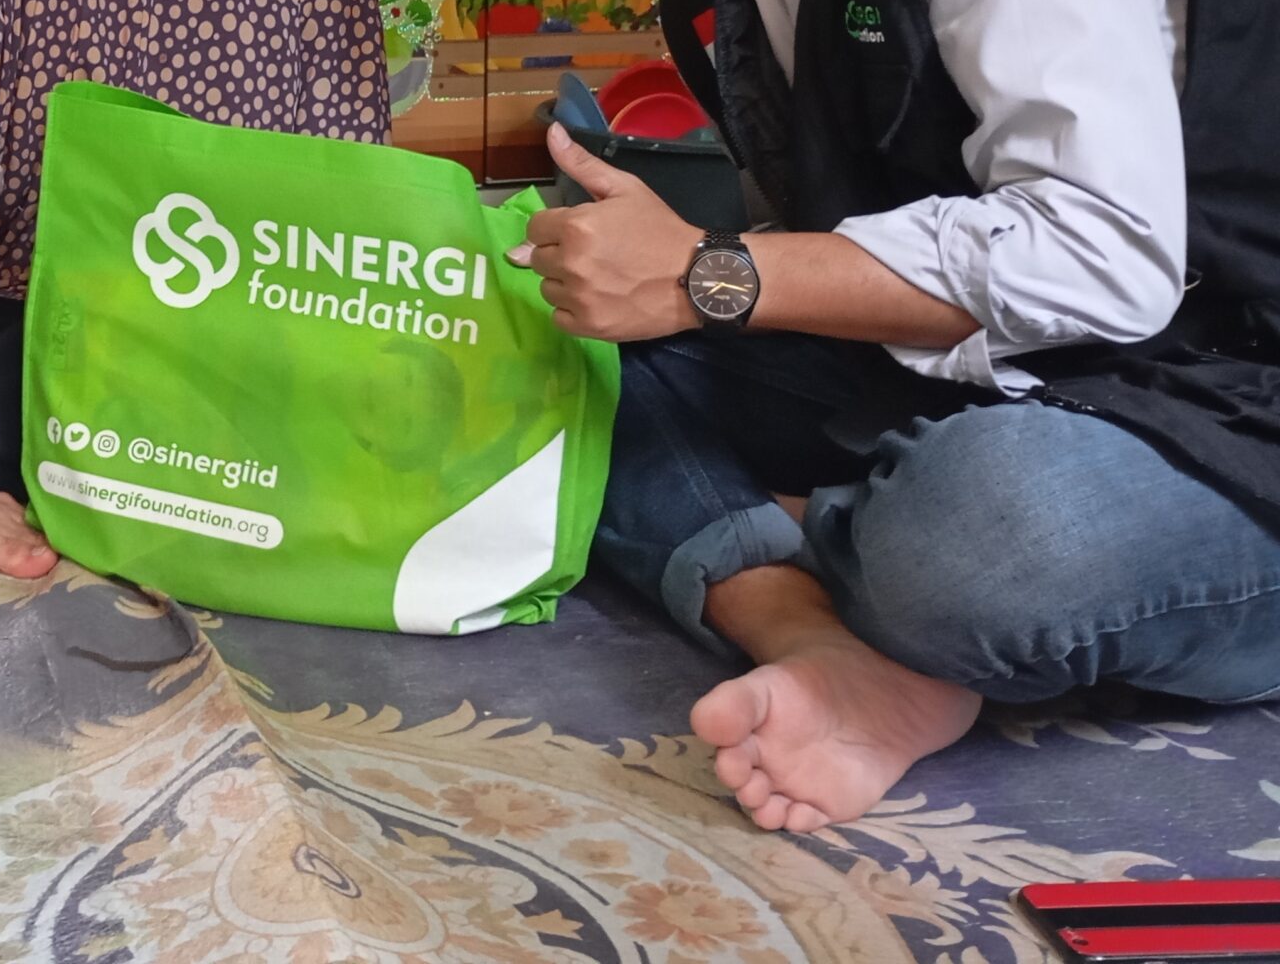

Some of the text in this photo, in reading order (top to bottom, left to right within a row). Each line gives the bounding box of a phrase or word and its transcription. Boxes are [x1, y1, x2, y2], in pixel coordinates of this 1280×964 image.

[253, 219, 487, 300] SINERGI
[248, 269, 479, 346] foundation
[127, 437, 279, 489] @sinergiid
[46, 469, 269, 543] www.sinergifoundation.org
